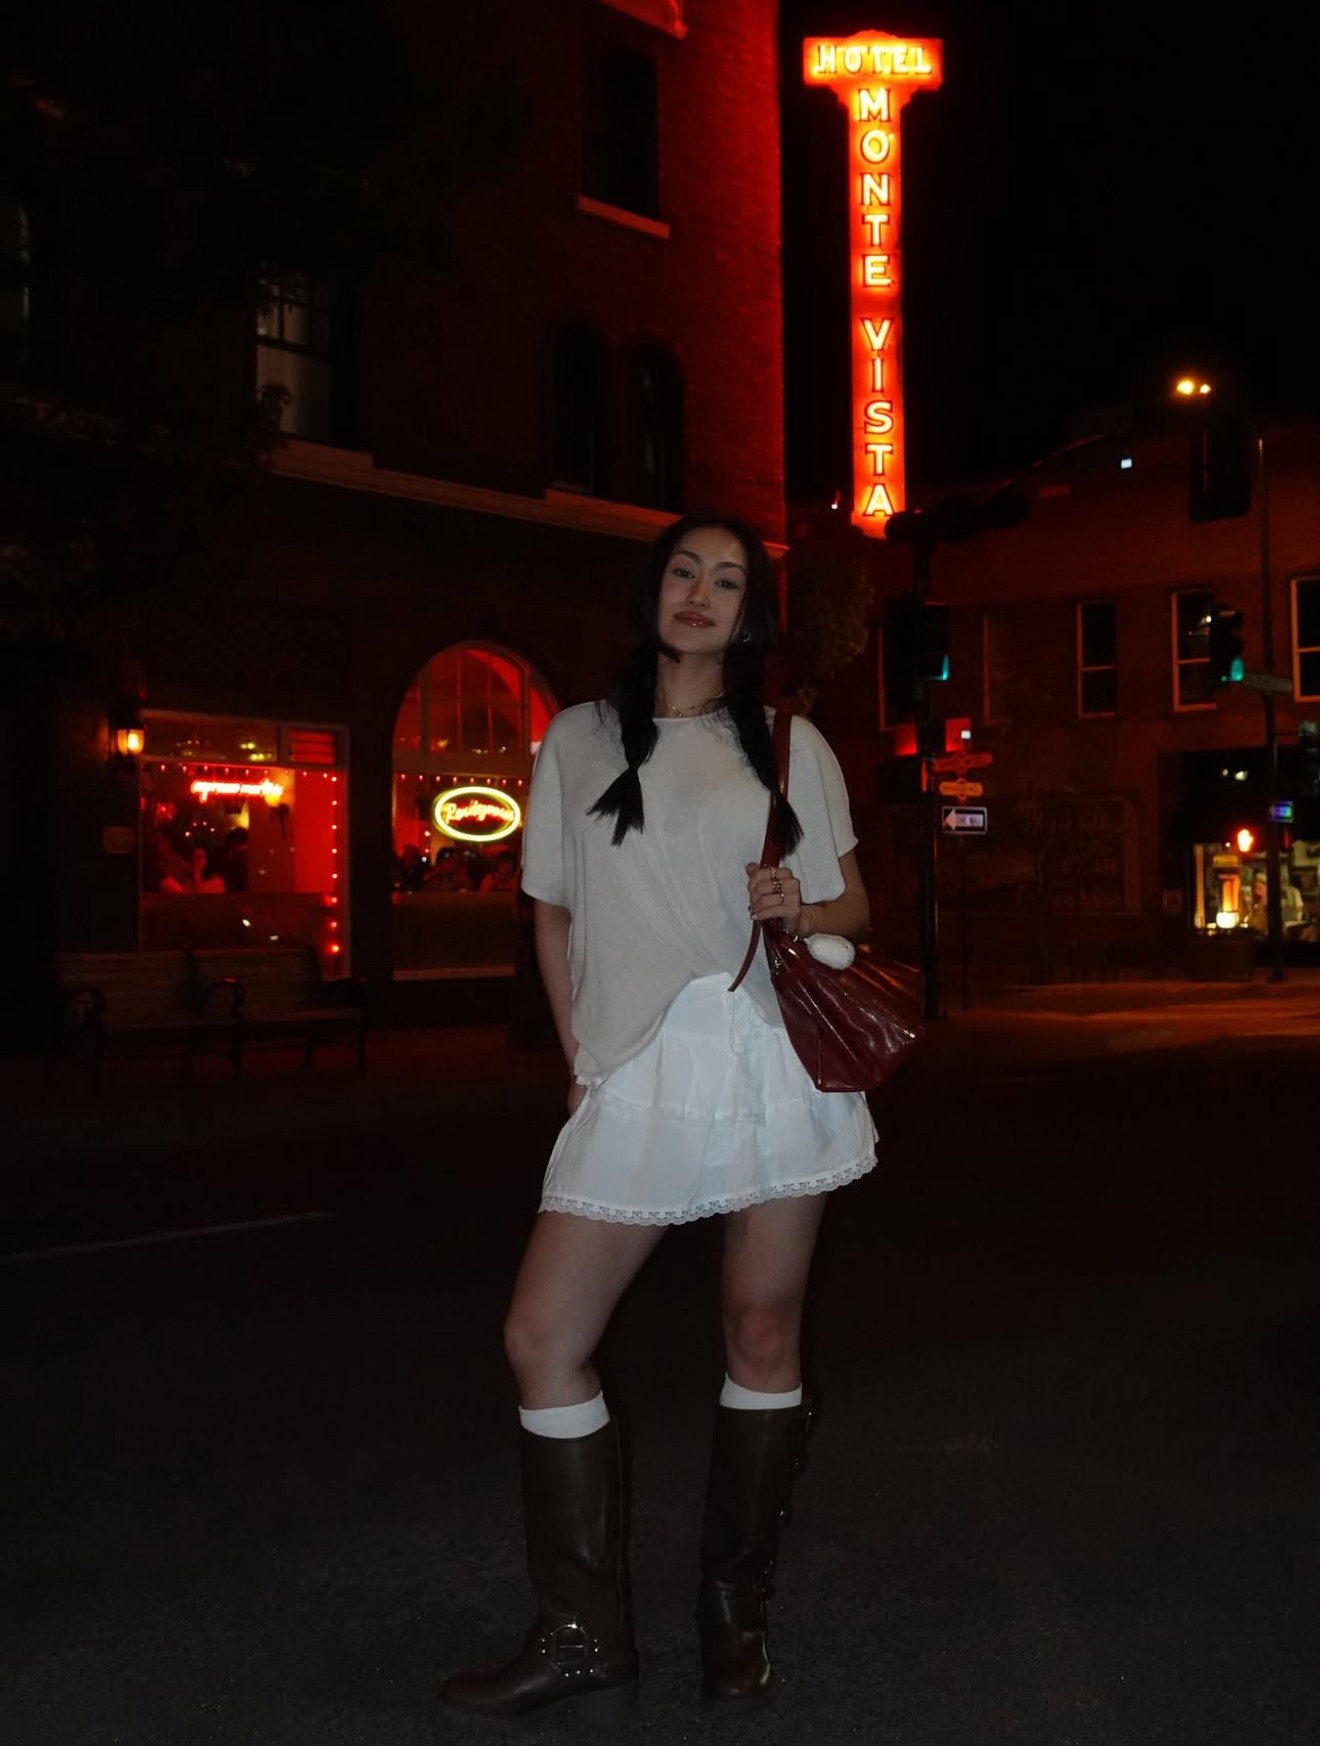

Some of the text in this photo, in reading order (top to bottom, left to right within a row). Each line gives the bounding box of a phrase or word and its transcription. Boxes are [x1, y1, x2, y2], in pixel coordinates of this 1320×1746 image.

[814, 44, 932, 75] HOTEL
[858, 88, 895, 517] MONTE VISTA
